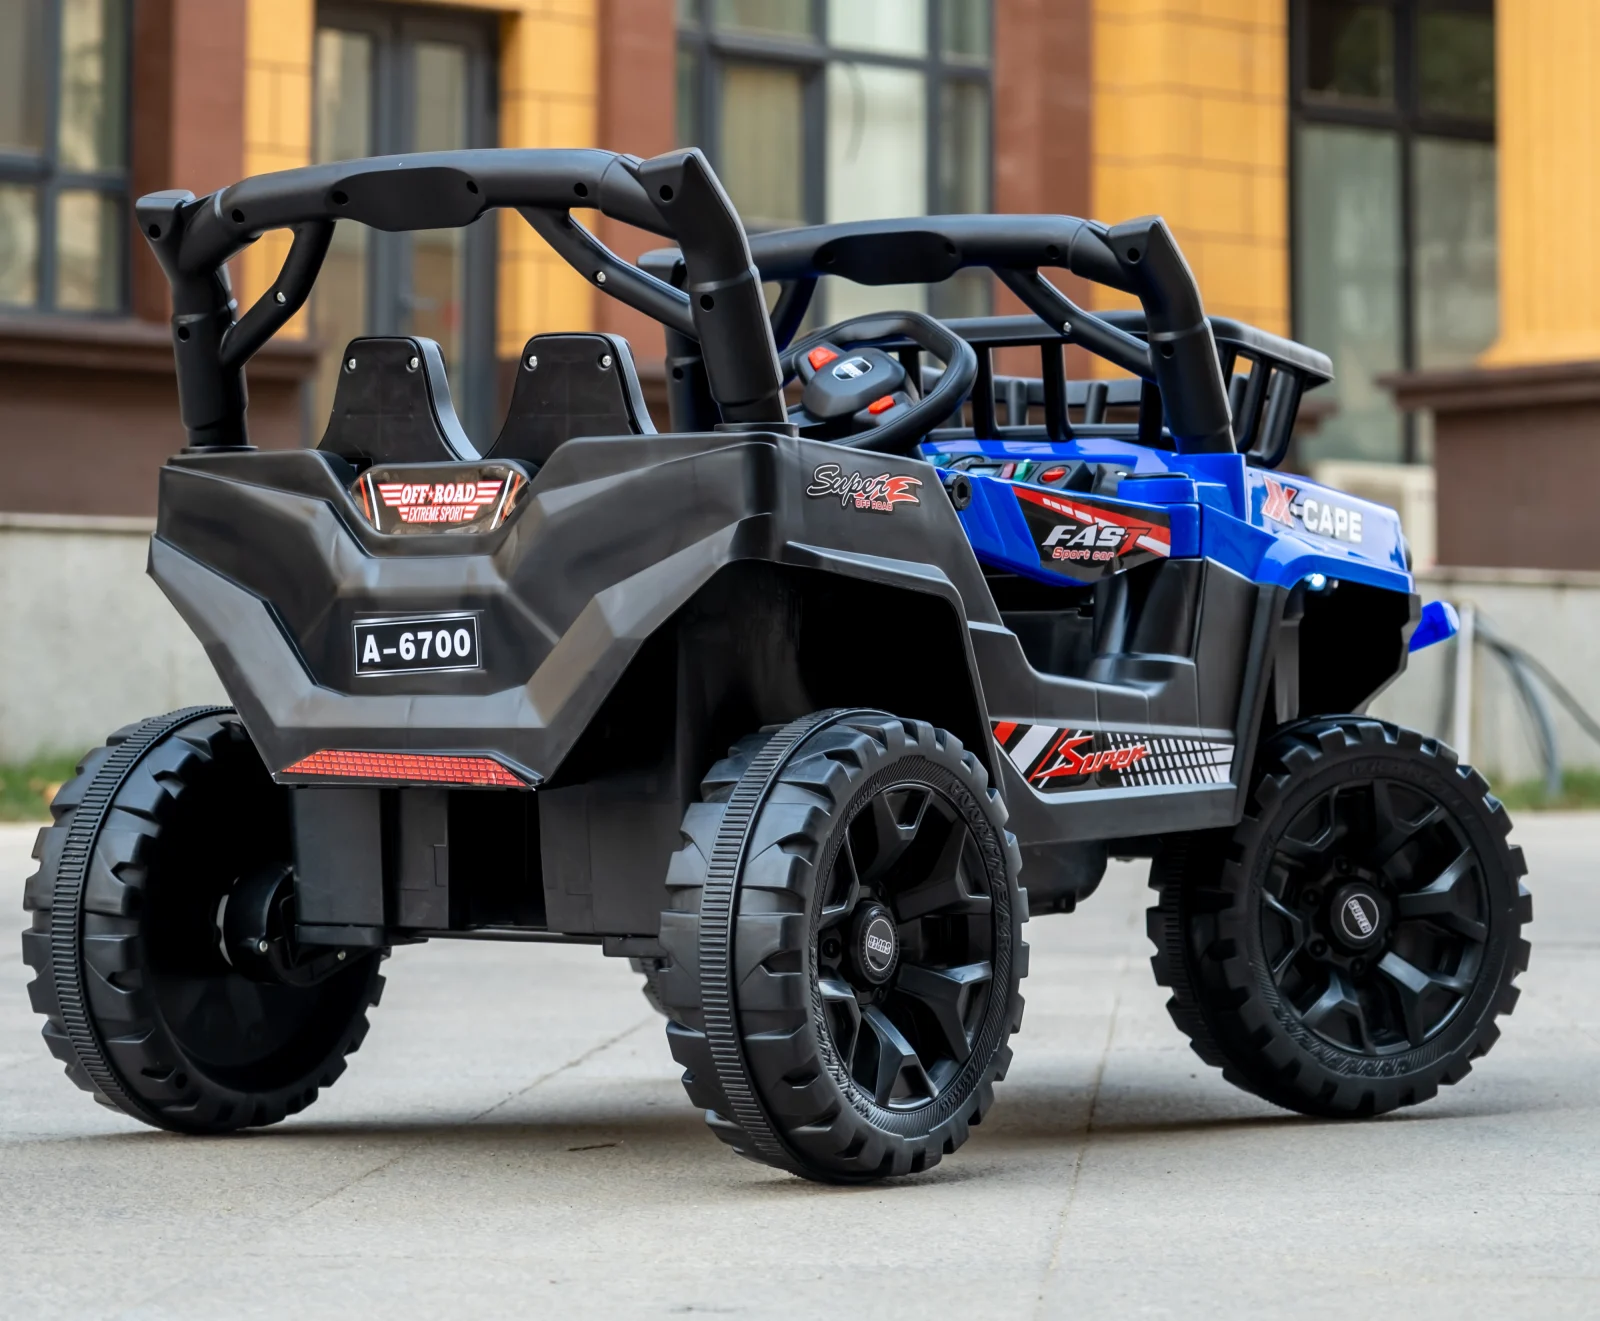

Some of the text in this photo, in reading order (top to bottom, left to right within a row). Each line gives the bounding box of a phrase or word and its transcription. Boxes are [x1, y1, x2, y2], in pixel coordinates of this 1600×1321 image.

[401, 483, 477, 504] OFF ROAD
[408, 505, 465, 522] EXTREME SPORT
[855, 499, 893, 511] OFF ROAD
[1261, 475, 1363, 543] X-CAPE
[1041, 524, 1151, 556] FAST
[1052, 546, 1114, 561] Sport car
[362, 628, 471, 663] A-6700
